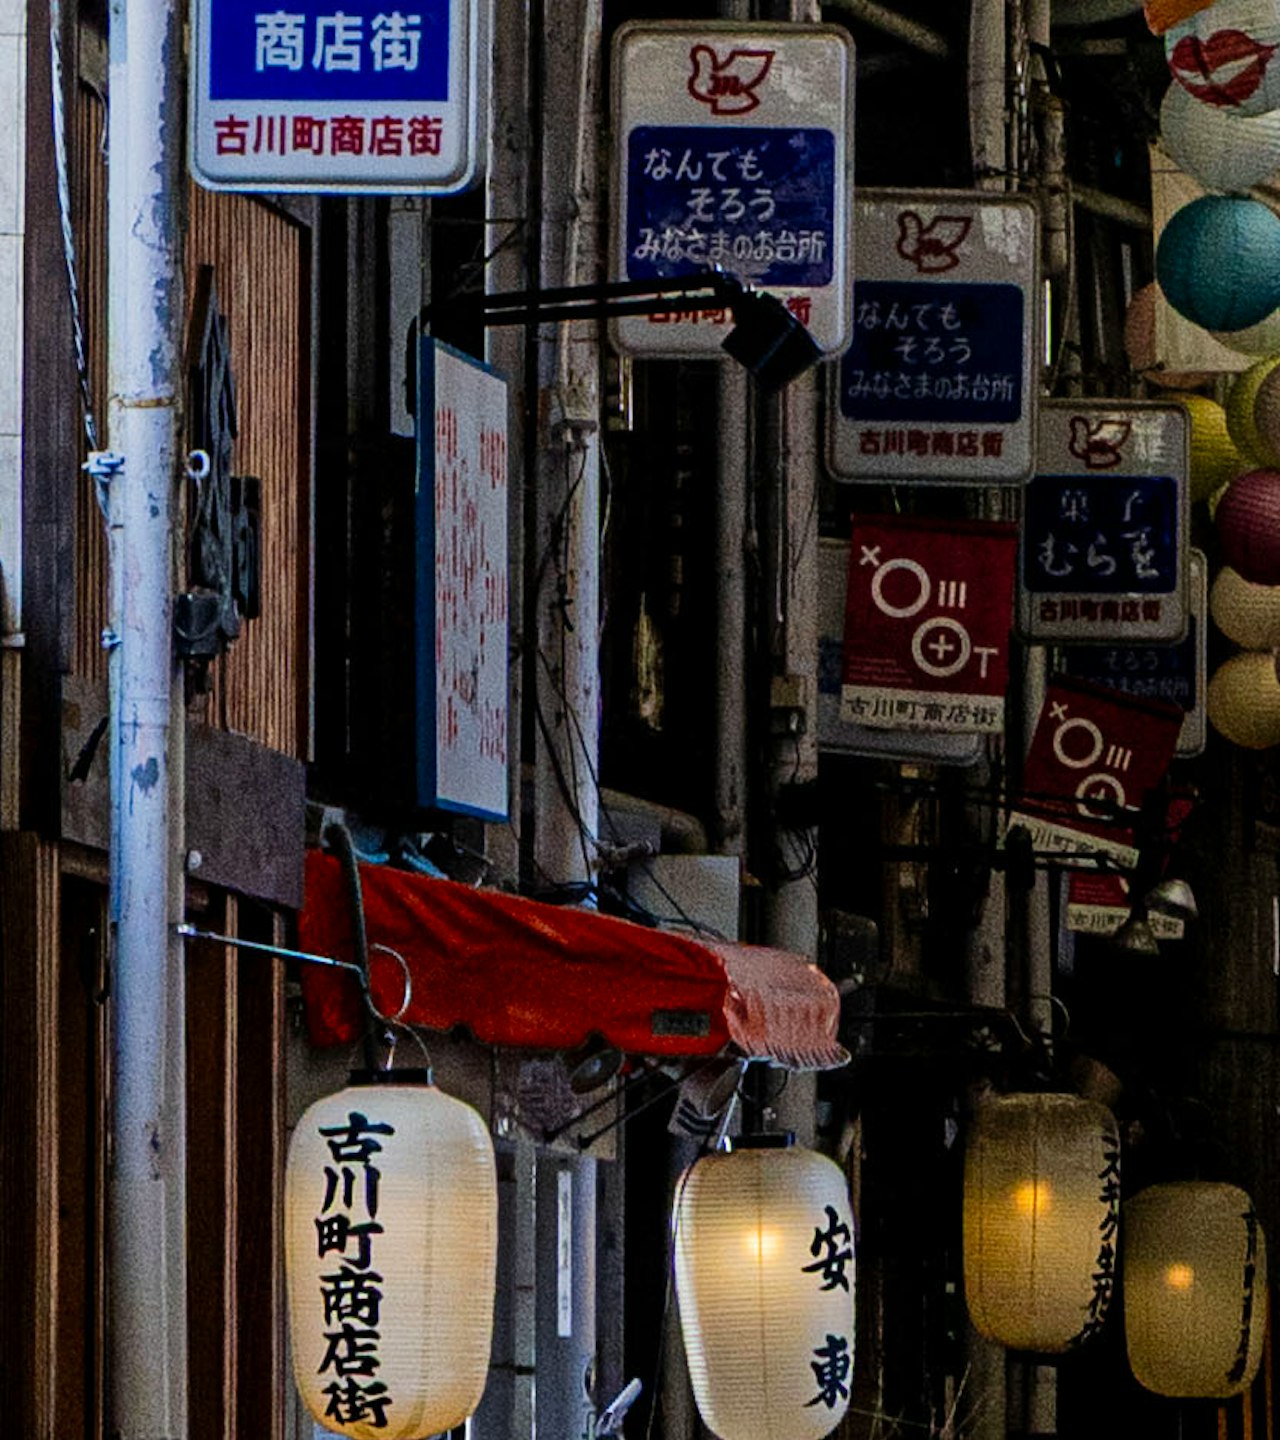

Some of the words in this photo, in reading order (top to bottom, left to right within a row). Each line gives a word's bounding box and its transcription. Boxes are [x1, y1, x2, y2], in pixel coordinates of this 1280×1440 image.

[254, 11, 421, 73] 商店街
[214, 114, 444, 156] 古川町商店街
[643, 148, 765, 182] なんでも
[686, 187, 777, 222] そろう
[633, 228, 826, 262] みなさまのお台所
[894, 336, 973, 364] そろう
[849, 370, 1015, 402] みなさまのお台所
[859, 429, 1004, 457] 古川町商店街
[845, 695, 998, 727] 古川町商店街
[315, 1113, 395, 1427] 古川町商店街
[802, 1206, 852, 1408] 安東
